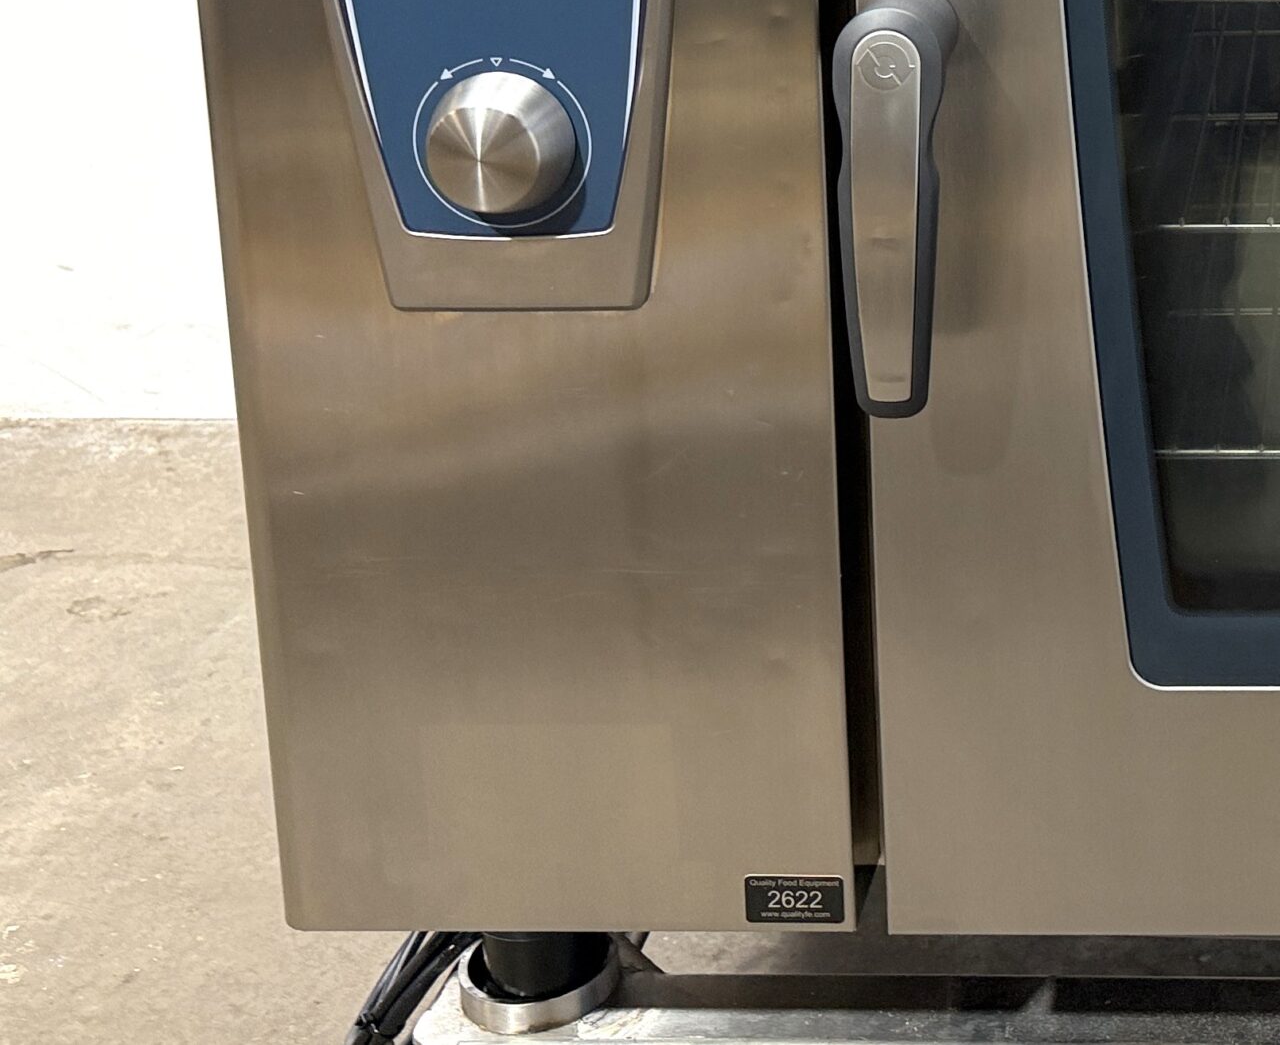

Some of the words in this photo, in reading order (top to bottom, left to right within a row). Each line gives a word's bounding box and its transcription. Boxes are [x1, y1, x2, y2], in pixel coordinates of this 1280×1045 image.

[749, 879, 777, 887] Quality
[778, 879, 798, 887] Food
[768, 890, 823, 908] 2622
